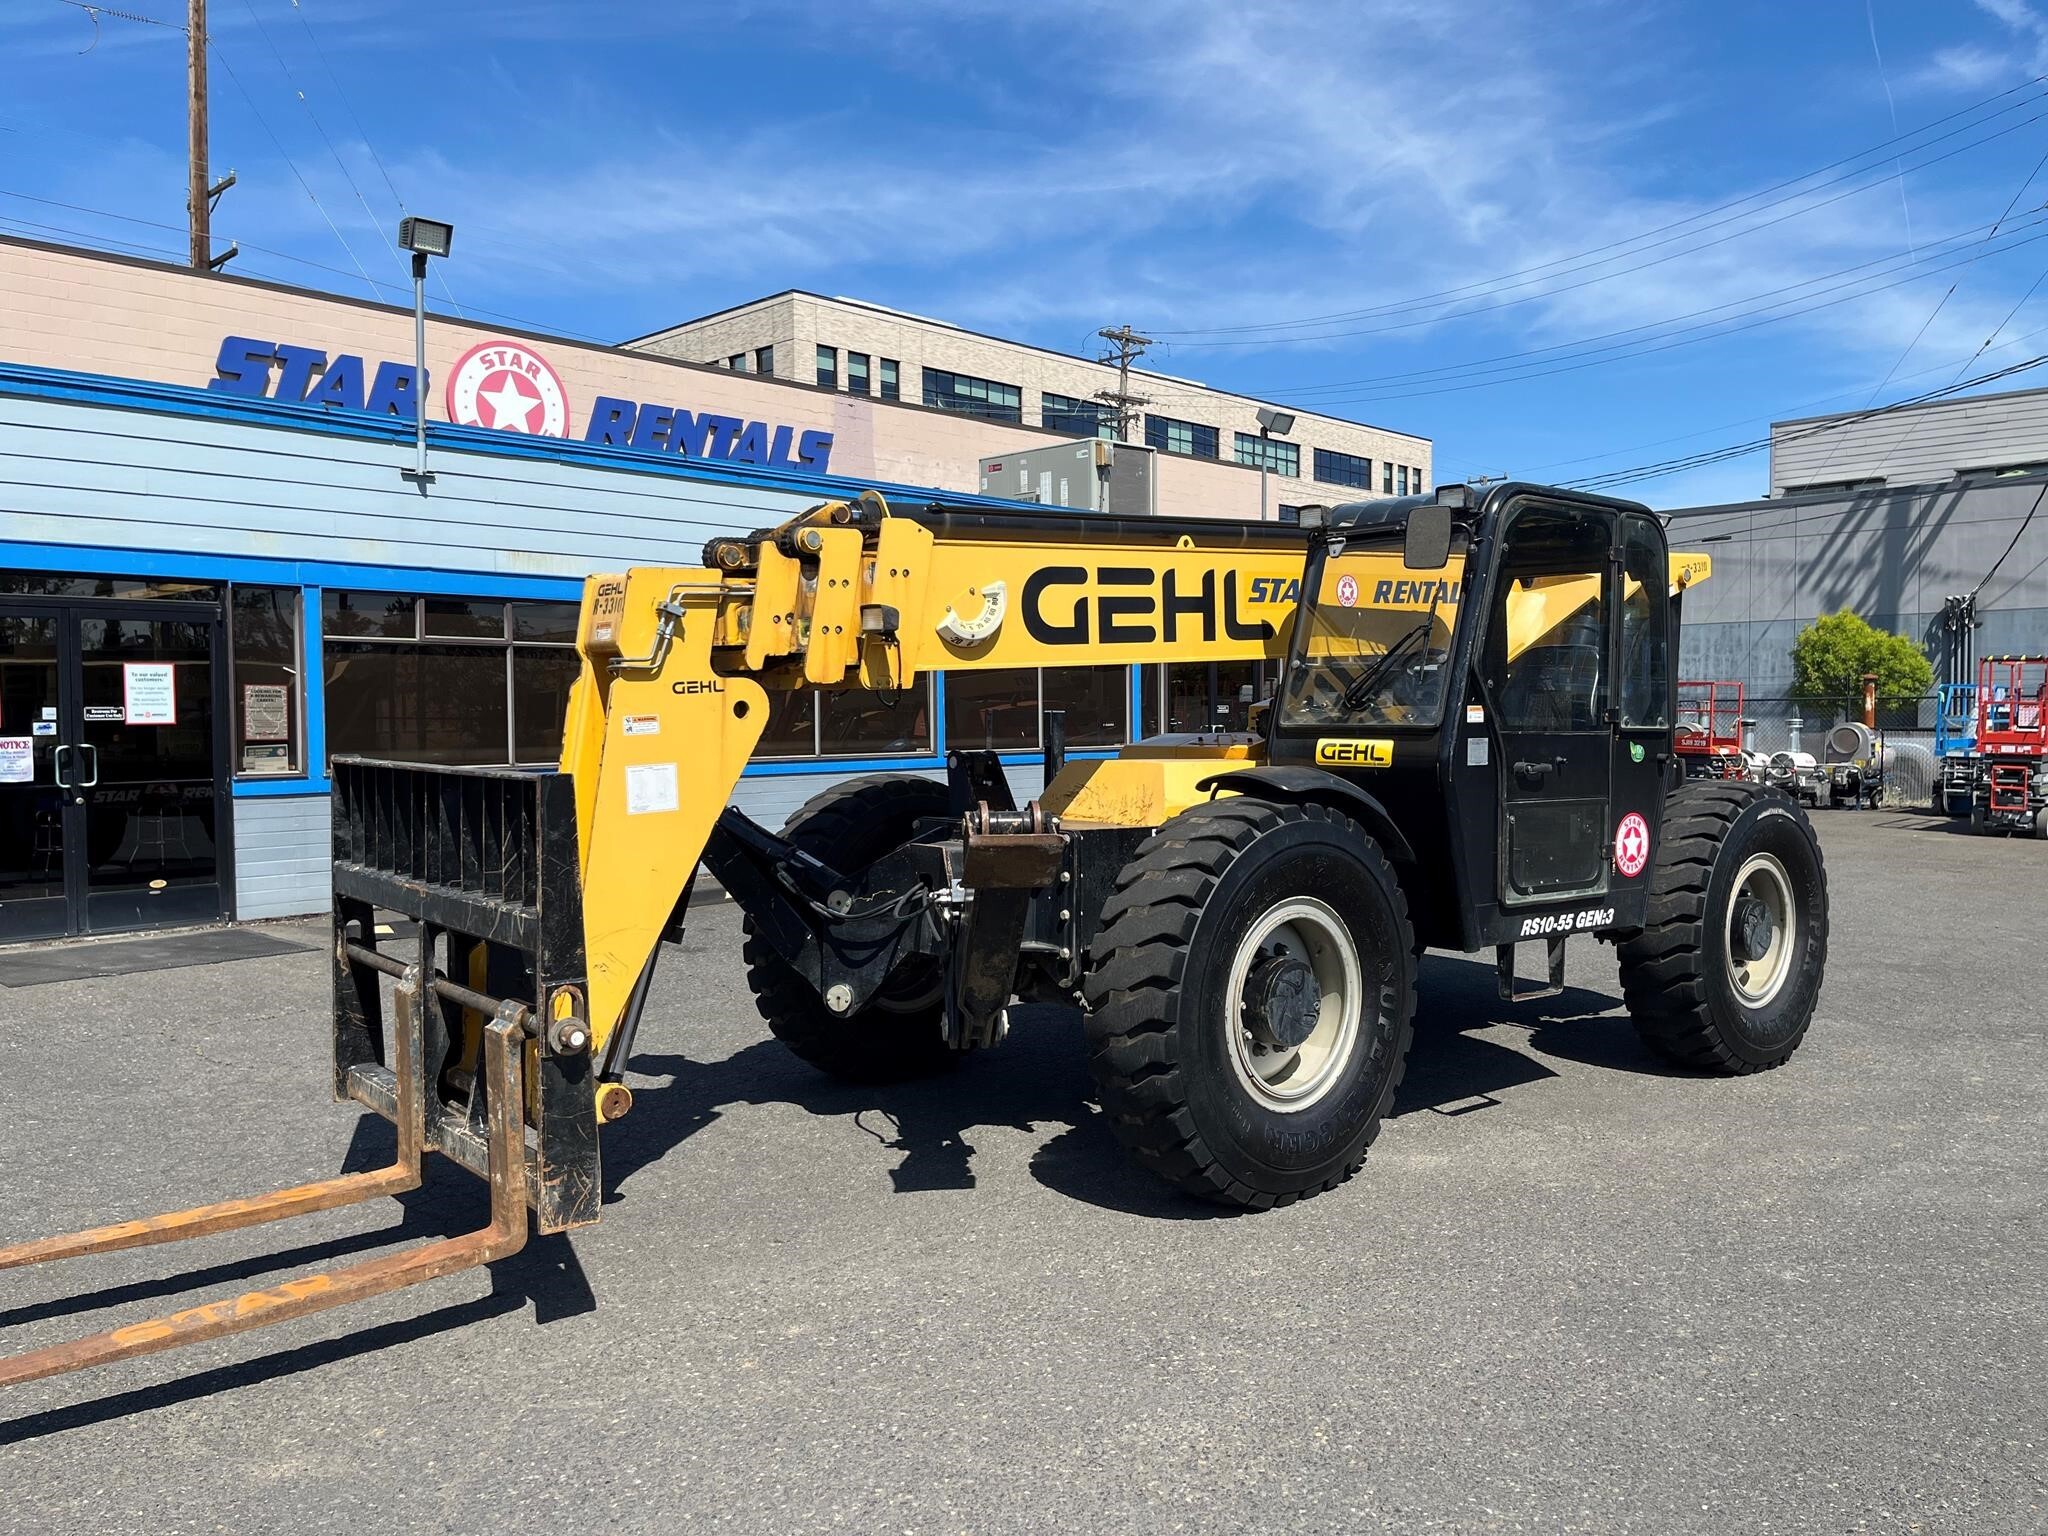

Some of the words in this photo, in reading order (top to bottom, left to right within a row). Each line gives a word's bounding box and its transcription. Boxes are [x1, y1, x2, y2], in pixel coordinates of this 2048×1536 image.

[479, 351, 541, 381] STAR
[207, 335, 430, 418] STAR
[585, 395, 835, 475] RENTALS
[598, 582, 624, 597] GEHL
[1247, 577, 1300, 603] STA
[1373, 580, 1460, 604] RENTAL
[1021, 566, 1274, 645] GEHL
[672, 680, 724, 695] GEHL
[1321, 743, 1385, 762] GEHL
[1623, 818, 1642, 829] STAR
[1520, 913, 1575, 936] RS10-55
[1575, 907, 1615, 929] GEN:3
